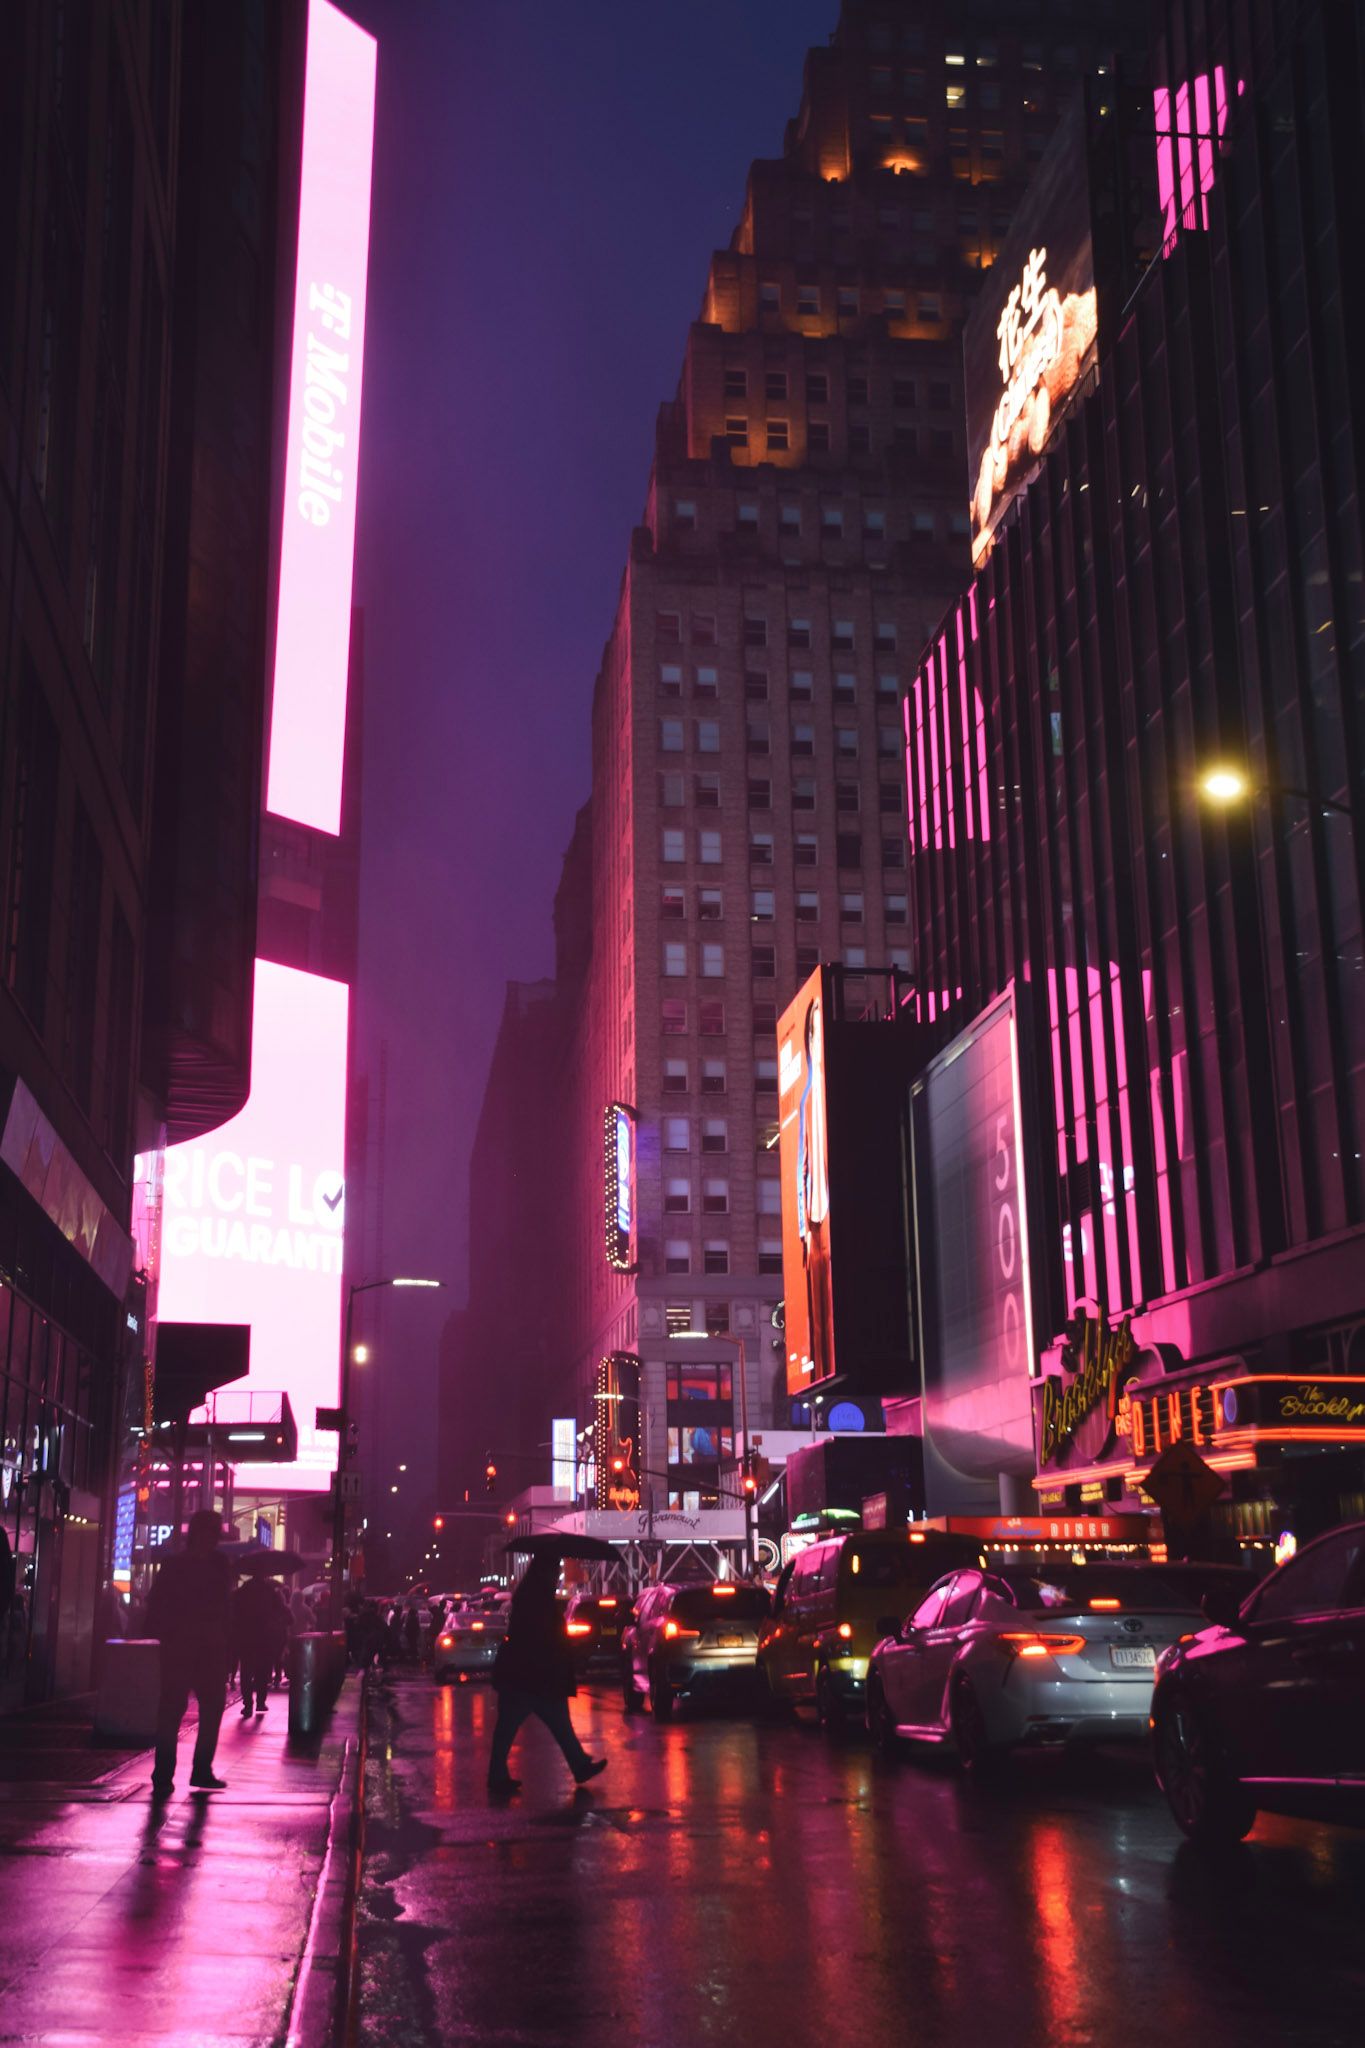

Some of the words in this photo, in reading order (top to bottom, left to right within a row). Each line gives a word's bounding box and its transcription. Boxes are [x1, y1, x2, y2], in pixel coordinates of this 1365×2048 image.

[297, 331, 349, 527] Mobile
[1297, 1384, 1325, 1401] The
[637, 1512, 701, 1534] Paramount
[1050, 1522, 1110, 1538] DINER
